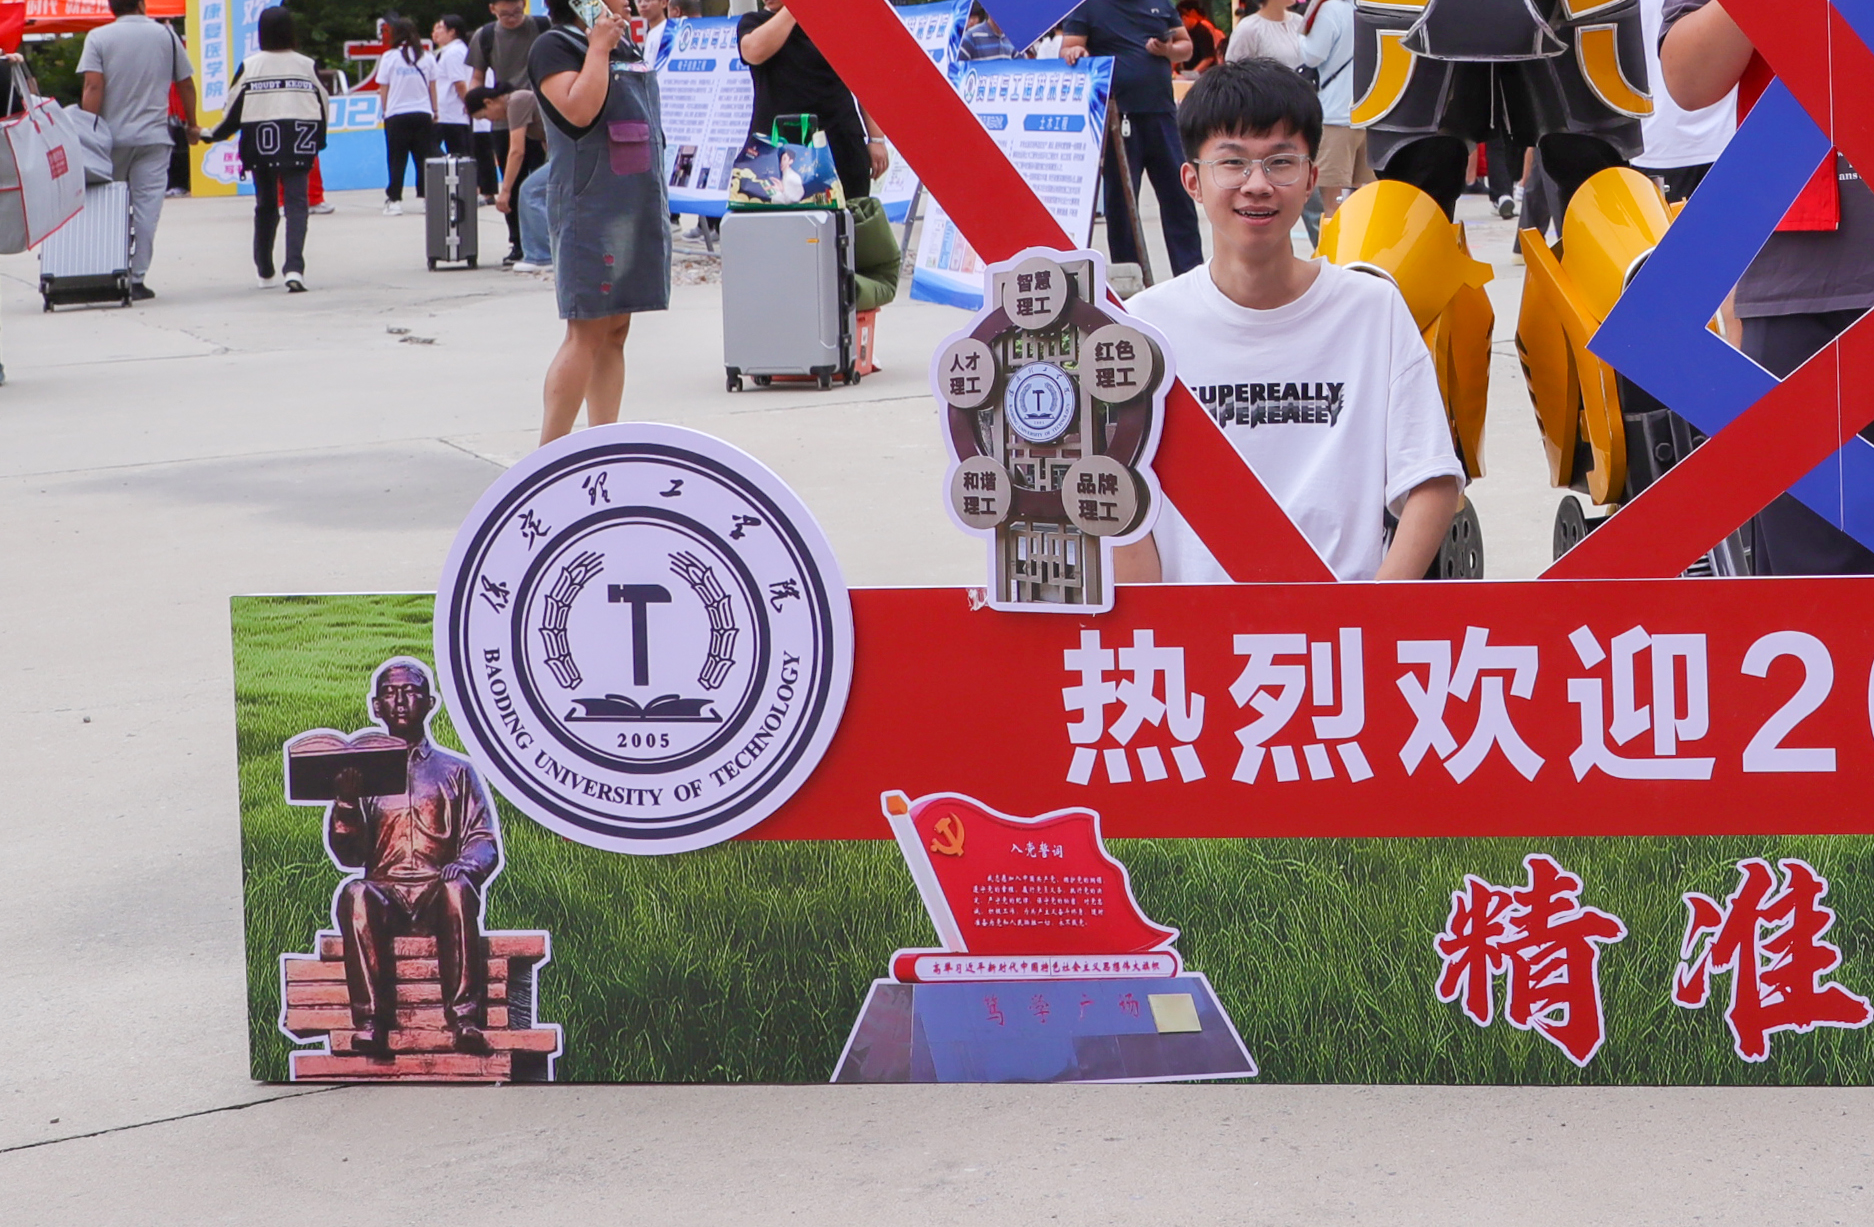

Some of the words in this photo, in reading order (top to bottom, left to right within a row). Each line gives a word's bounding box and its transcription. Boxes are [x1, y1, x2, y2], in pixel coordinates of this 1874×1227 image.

[203, 2, 224, 98] 康复医学院
[1017, 270, 1051, 292] 智慧
[1017, 298, 1051, 316] 理工
[1095, 340, 1136, 362] 红色
[950, 352, 981, 372] 人才
[950, 377, 981, 396] 理工
[1096, 367, 1136, 387] 理工
[964, 471, 997, 492] 和谐
[1077, 473, 1118, 495] 品牌
[964, 496, 997, 515] 理工
[1078, 499, 1119, 522] 理工
[483, 647, 533, 751] BAODING
[533, 749, 664, 806] UNIVERSITY
[674, 778, 703, 803] OF
[708, 650, 801, 789] TECHNOLOGY
[617, 732, 670, 748] 2005
[1011, 840, 1064, 859] 入党誓词
[932, 959, 1161, 975] 高举习近平新时代中国特色社会主义思想伟大旗帜
[983, 993, 1140, 1026] 笃学广场
